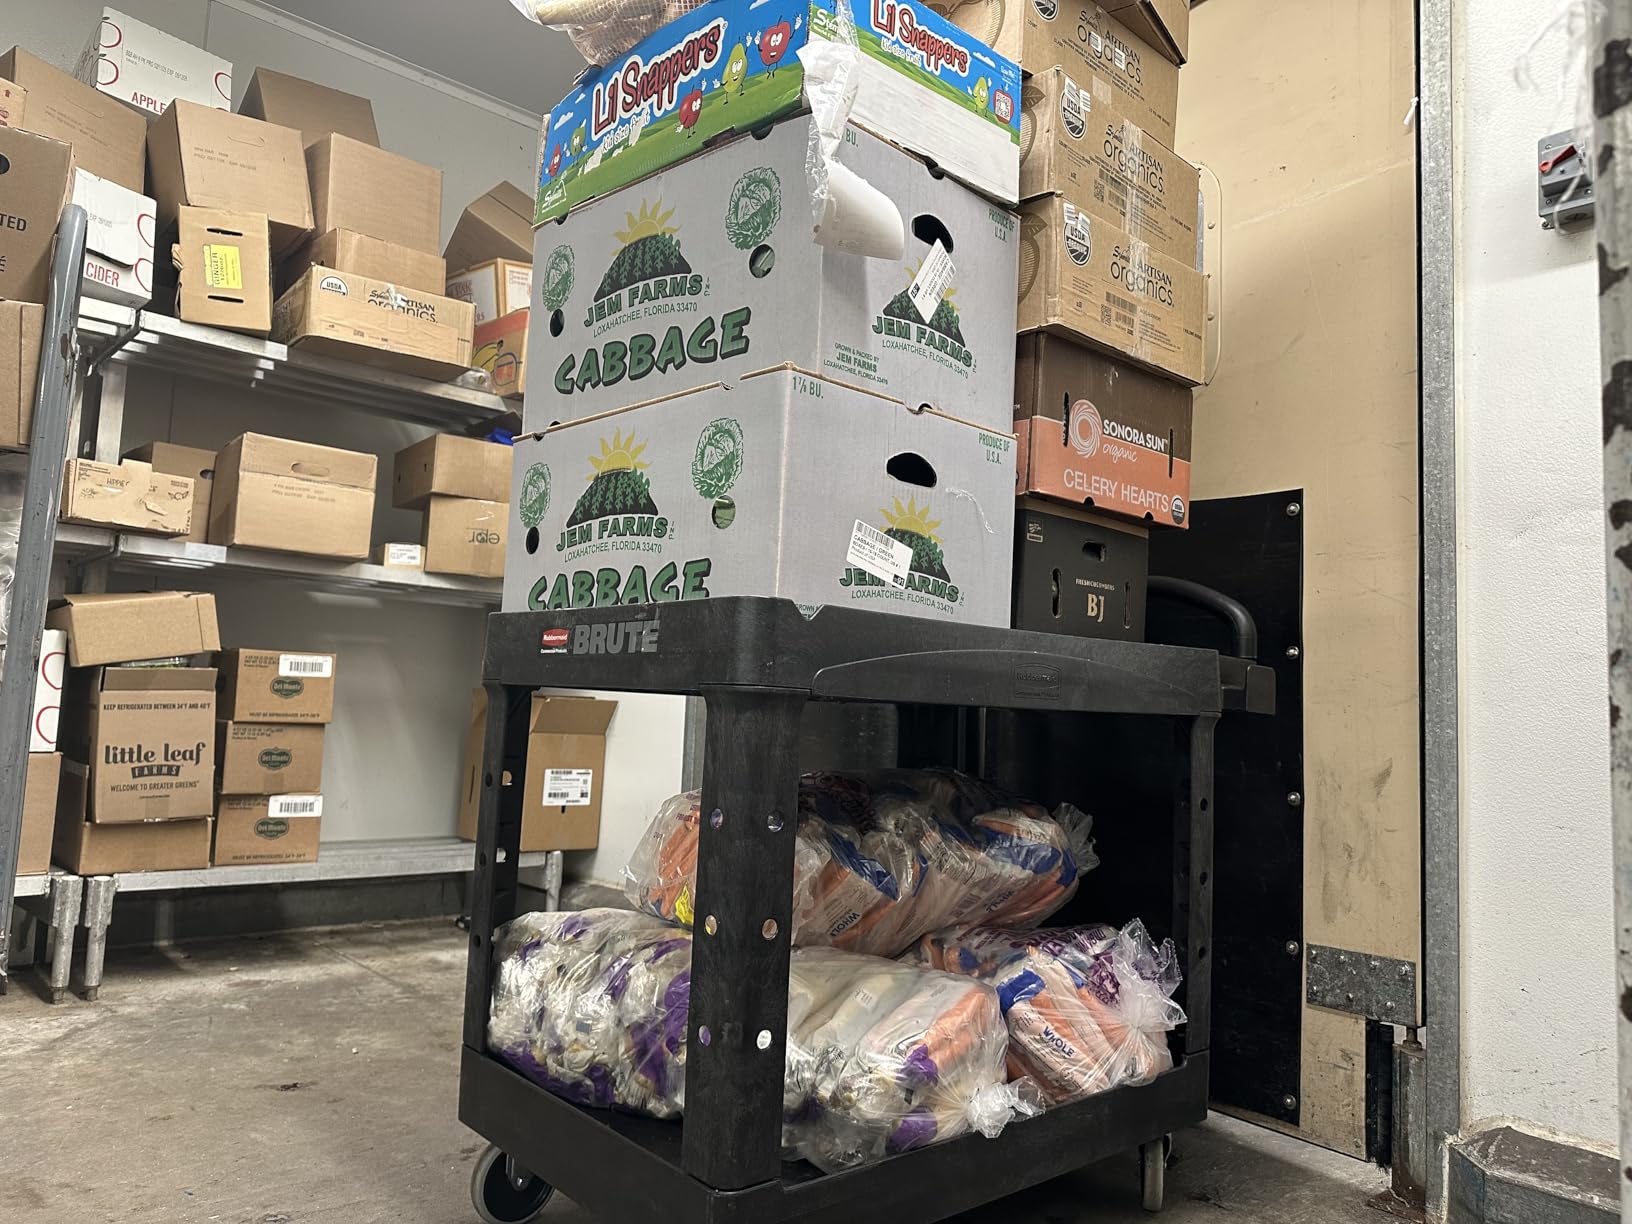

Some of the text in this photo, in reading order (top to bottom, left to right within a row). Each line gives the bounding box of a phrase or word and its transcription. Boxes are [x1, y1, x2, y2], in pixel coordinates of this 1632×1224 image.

[899, 7, 968, 74] Snappers
[621, 23, 721, 112] Snappers
[131, 91, 167, 114] APPLE
[845, 130, 859, 148] BU.
[86, 262, 120, 288] CIDER
[326, 280, 342, 291] USDA
[1110, 261, 1172, 306] organics
[1136, 261, 1172, 286] ARTISAN
[584, 274, 702, 328] JEM FARMS
[593, 302, 698, 338] LOXAHATCHEE, FLORIDA 33470
[554, 306, 752, 395] CABBAGE
[872, 316, 972, 368] JEM FARMS
[836, 352, 878, 372] JEM FARMS
[882, 340, 968, 380] LOXAHATCHEE, FLORIDA 33470
[858, 370, 876, 382] FLORIDA
[810, 381, 824, 399] BU.
[978, 432, 1010, 452] PRODUCE OF
[1103, 418, 1165, 452] SONORA SUN
[986, 448, 1002, 464] U.S.A.
[1102, 442, 1138, 464] organic
[1064, 468, 1169, 513] CELERY HEARTS
[556, 516, 669, 552] JEM FARMS
[564, 540, 662, 563] LOXAHATCHEE, FLORIDA 33470
[528, 558, 712, 610] CABBAGE
[892, 572, 960, 602] ARMS
[851, 589, 954, 614] LOXAHATCHEE, FLORIDA 33470
[1087, 593, 1104, 622] BJ
[572, 620, 660, 654] BRUTE
[104, 742, 206, 766] little leaf
[135, 766, 177, 777] FARMS
[110, 784, 139, 792] WELCOME
[149, 782, 174, 790] GREATER
[1042, 1026, 1076, 1058] WHOLE
